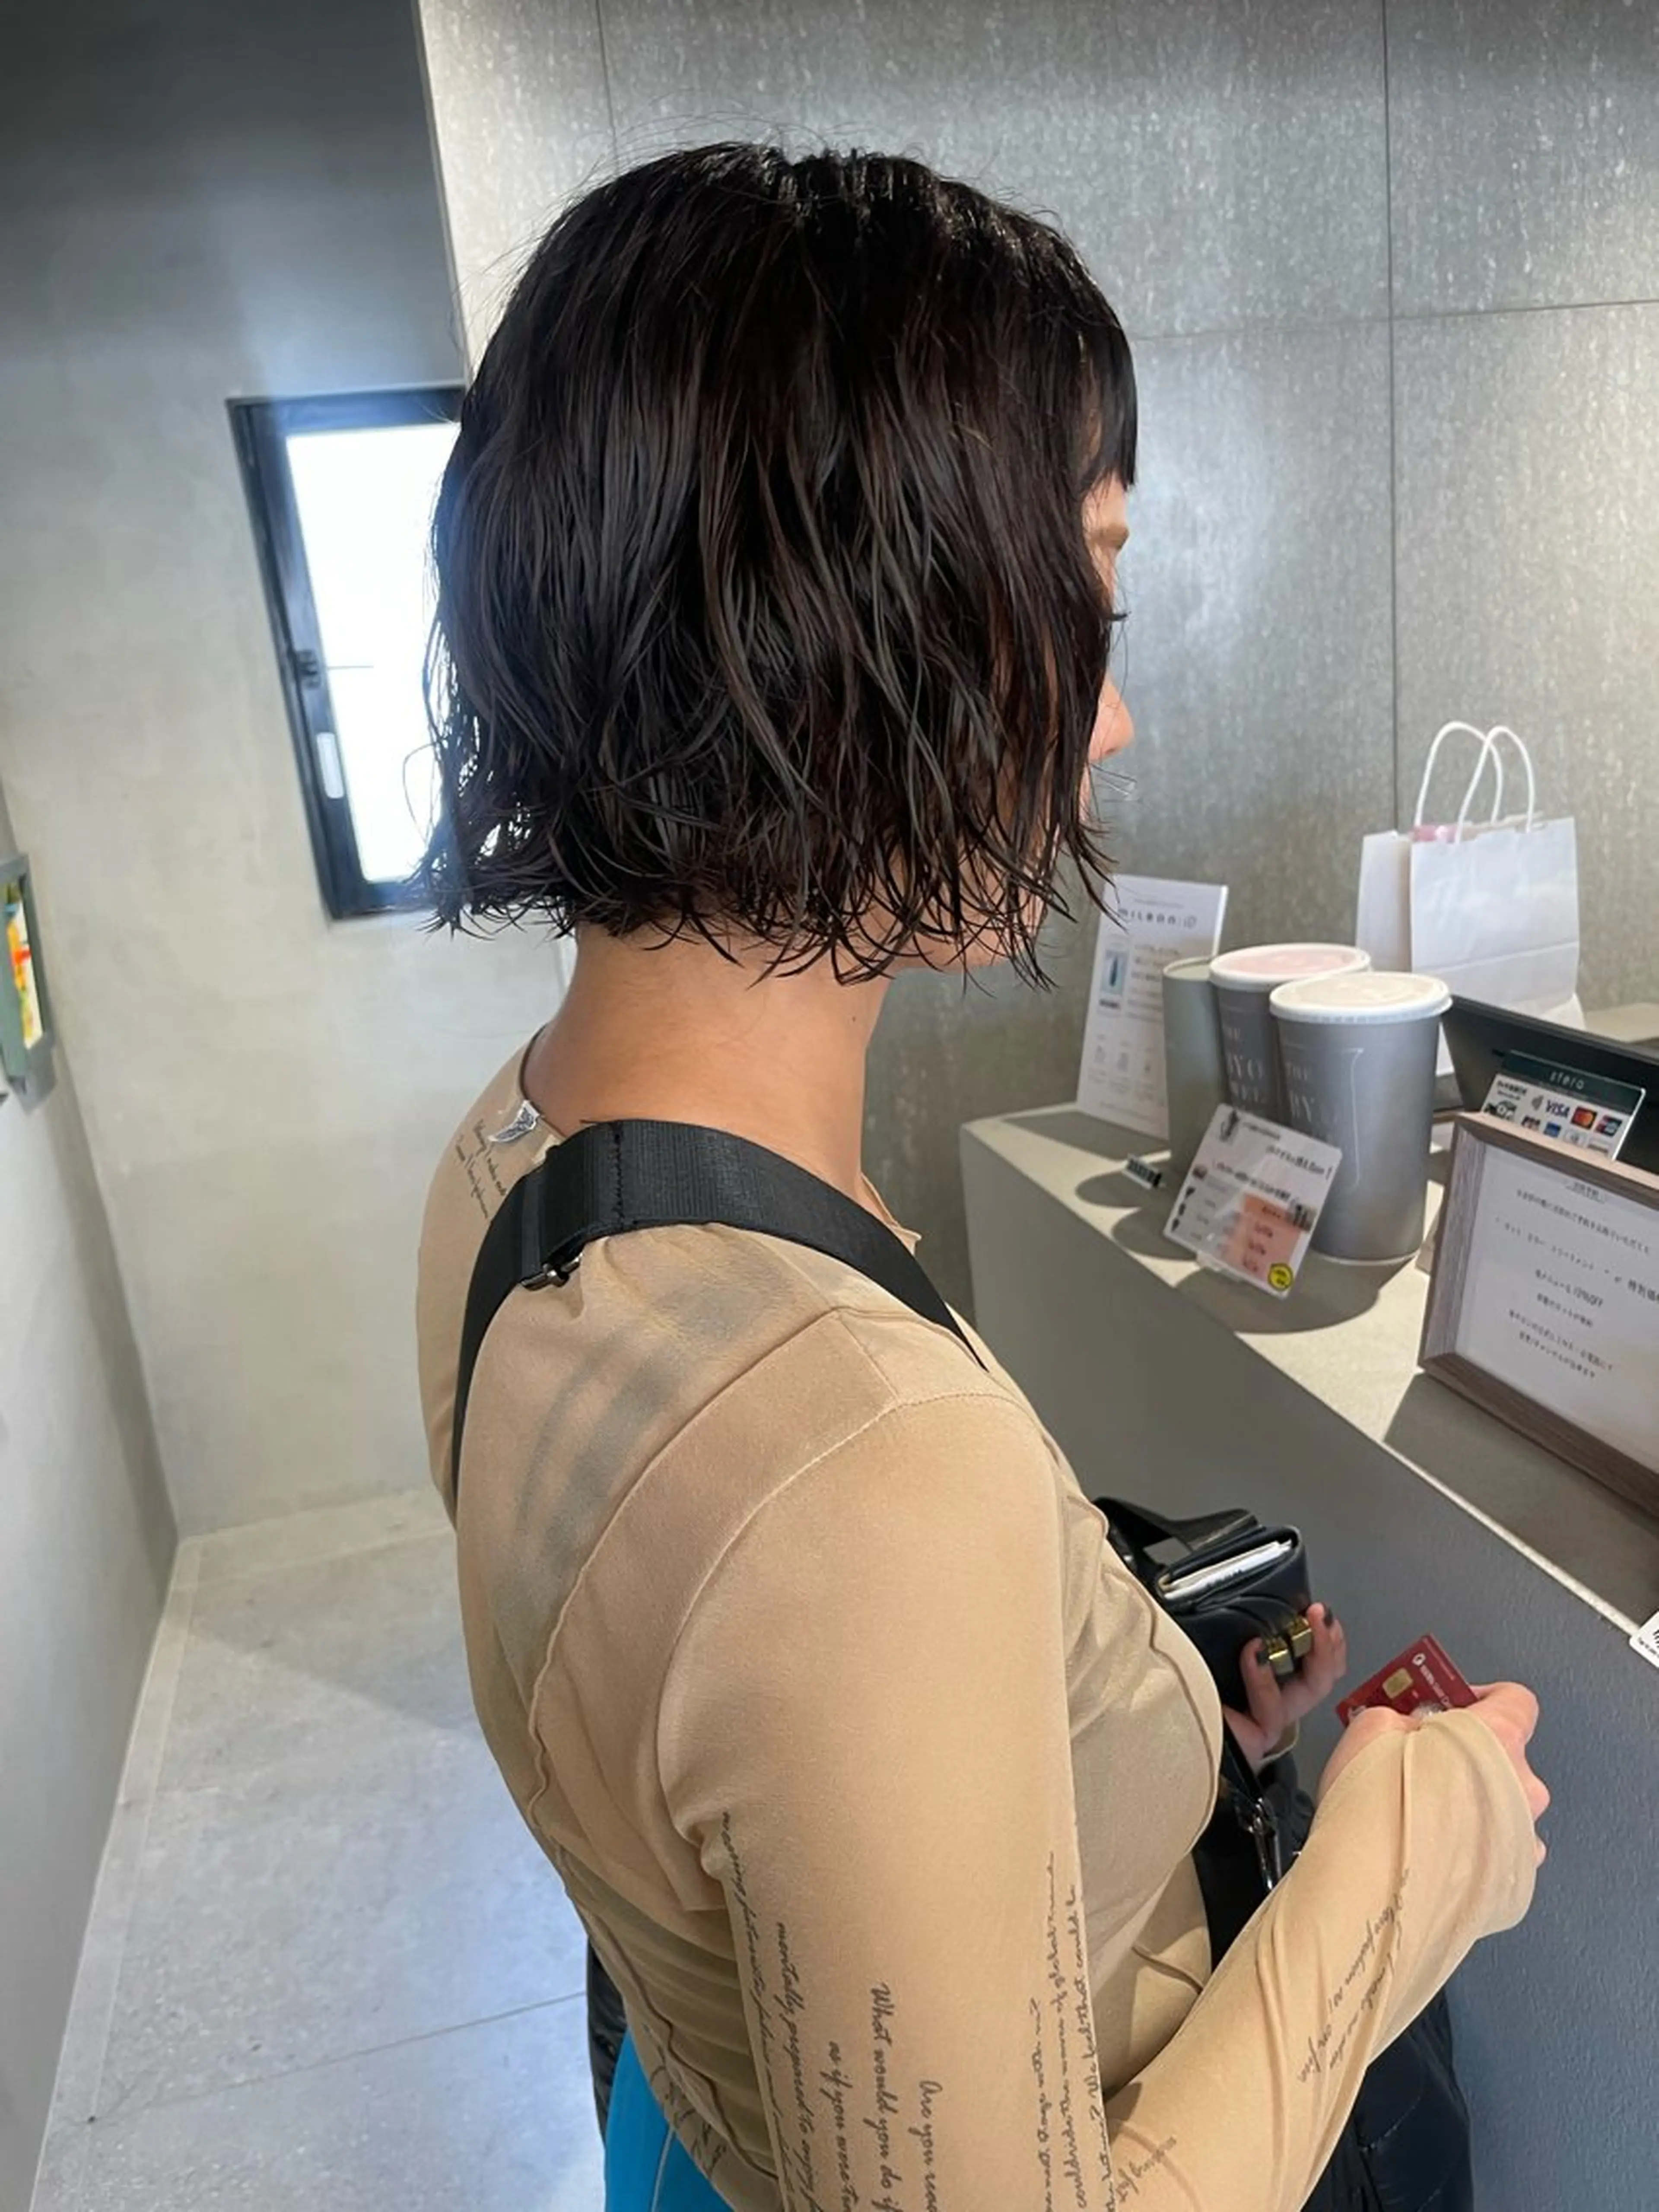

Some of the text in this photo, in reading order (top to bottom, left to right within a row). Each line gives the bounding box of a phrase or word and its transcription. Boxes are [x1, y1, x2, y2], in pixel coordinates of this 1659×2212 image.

[1545, 1100, 1570, 1119] VISA
[870, 1982, 894, 2046] What
[874, 2049, 898, 2114] would
[918, 2080, 943, 2119] Are
[863, 2117, 889, 2159] you
[907, 2123, 934, 2165] you
[880, 2164, 903, 2189] do
